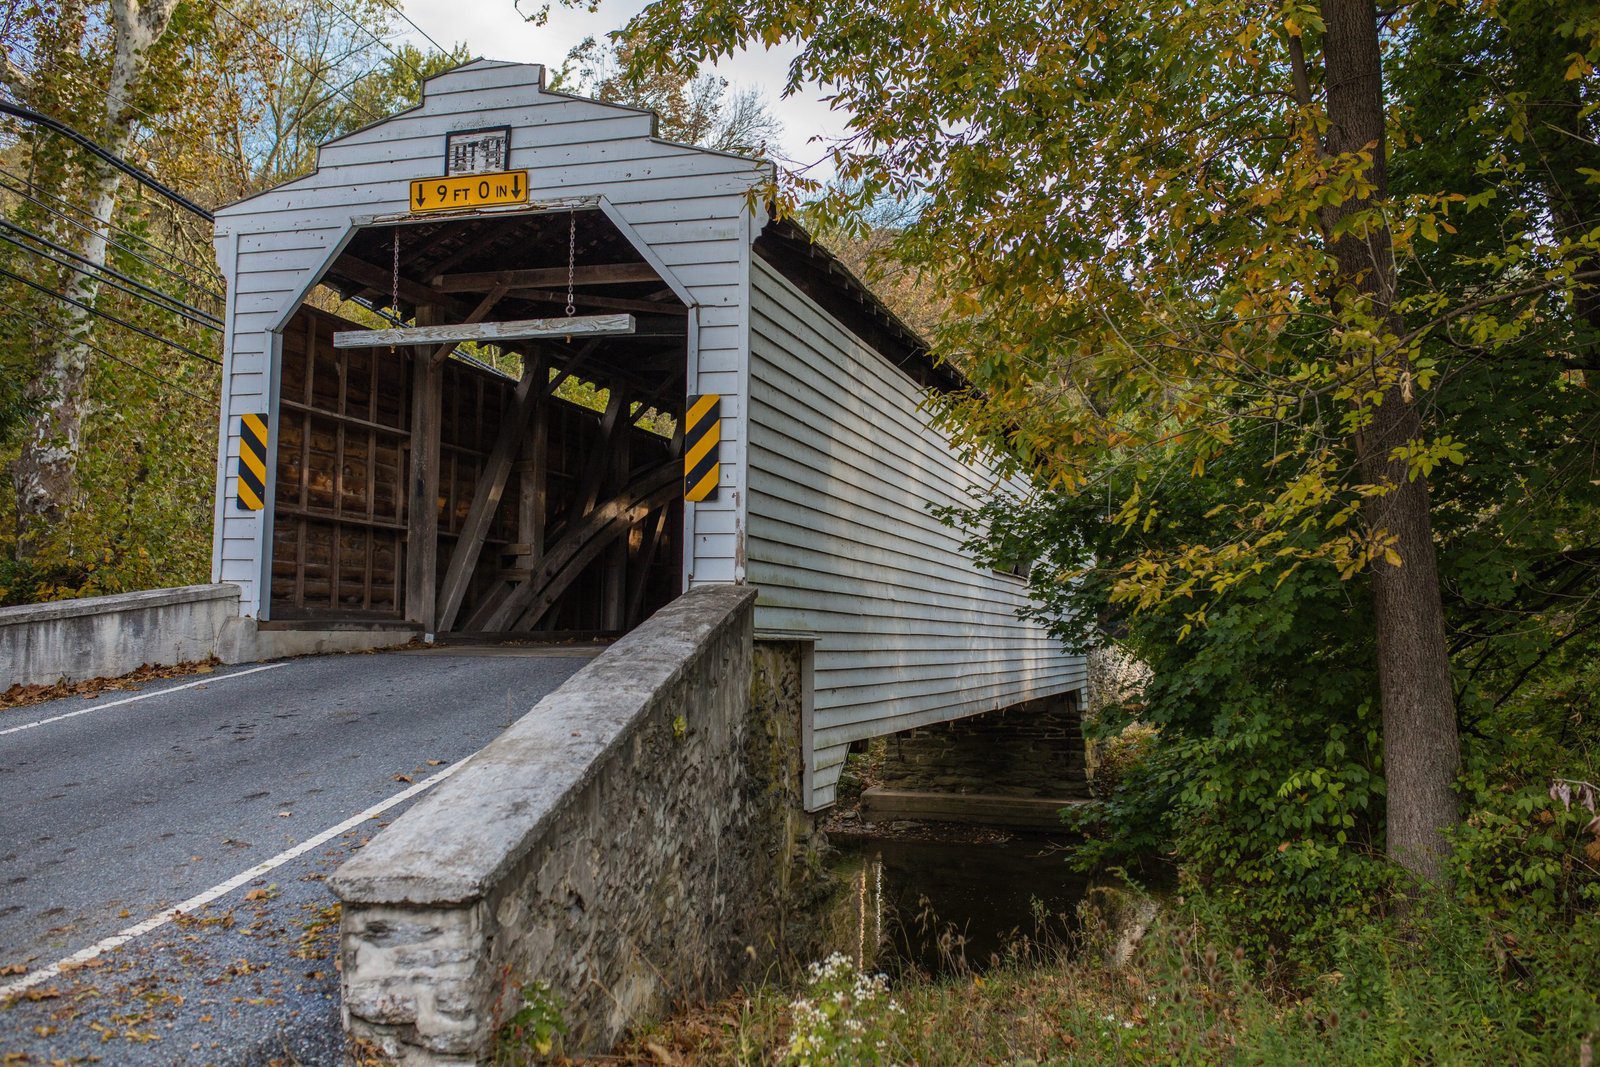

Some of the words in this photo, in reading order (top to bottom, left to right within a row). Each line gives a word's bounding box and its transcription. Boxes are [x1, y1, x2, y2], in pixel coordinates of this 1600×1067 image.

[437, 185, 448, 202] 9
[453, 188, 470, 201] FT
[478, 181, 490, 199] 0
[496, 185, 507, 198] IN
